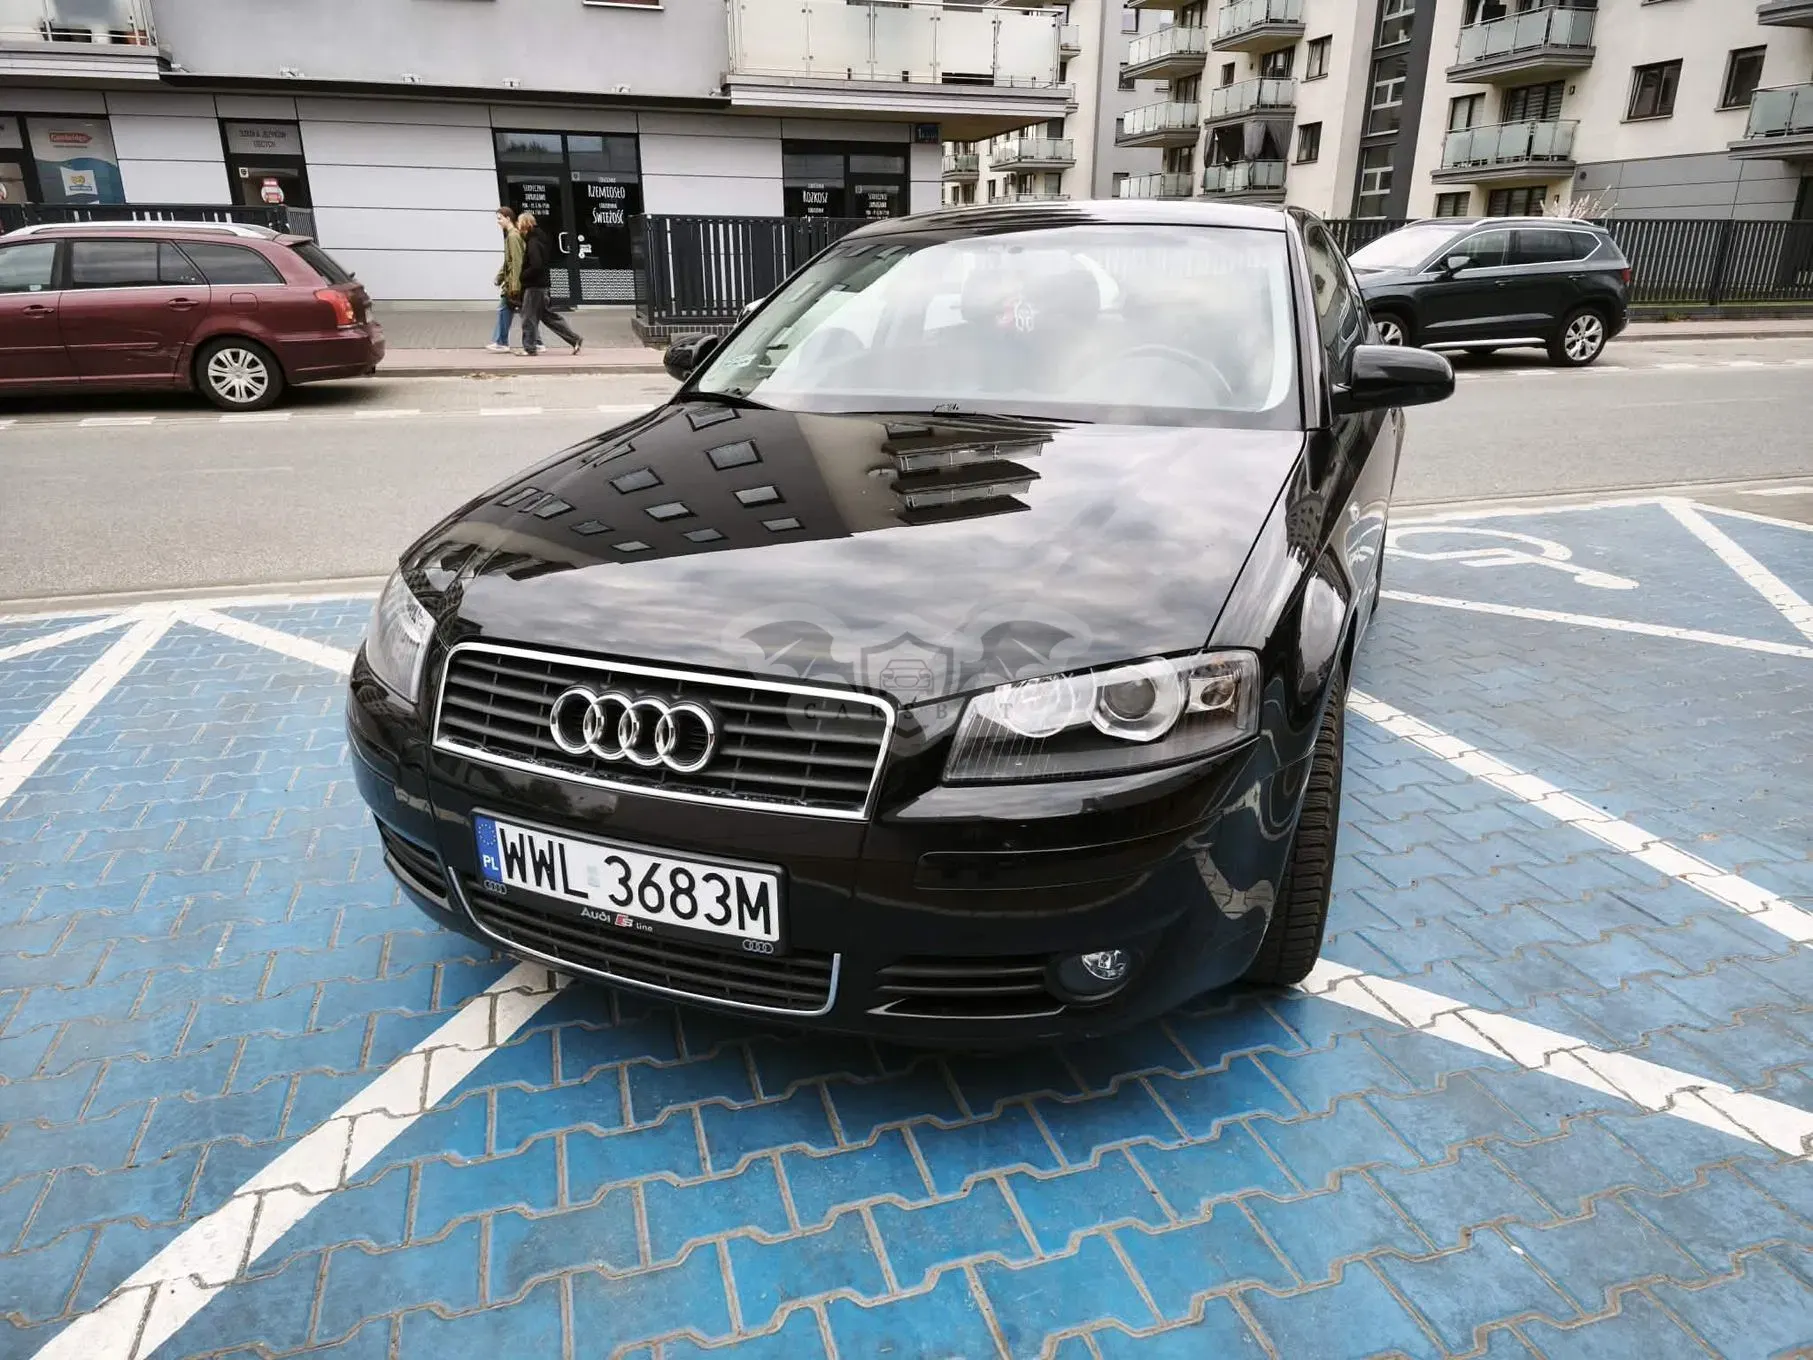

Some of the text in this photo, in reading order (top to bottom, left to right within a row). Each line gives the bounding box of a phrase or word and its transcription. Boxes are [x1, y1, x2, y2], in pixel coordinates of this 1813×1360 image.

[483, 855, 500, 872] PL
[499, 827, 772, 936] WWL 3683M
[580, 906, 611, 924] Audi
